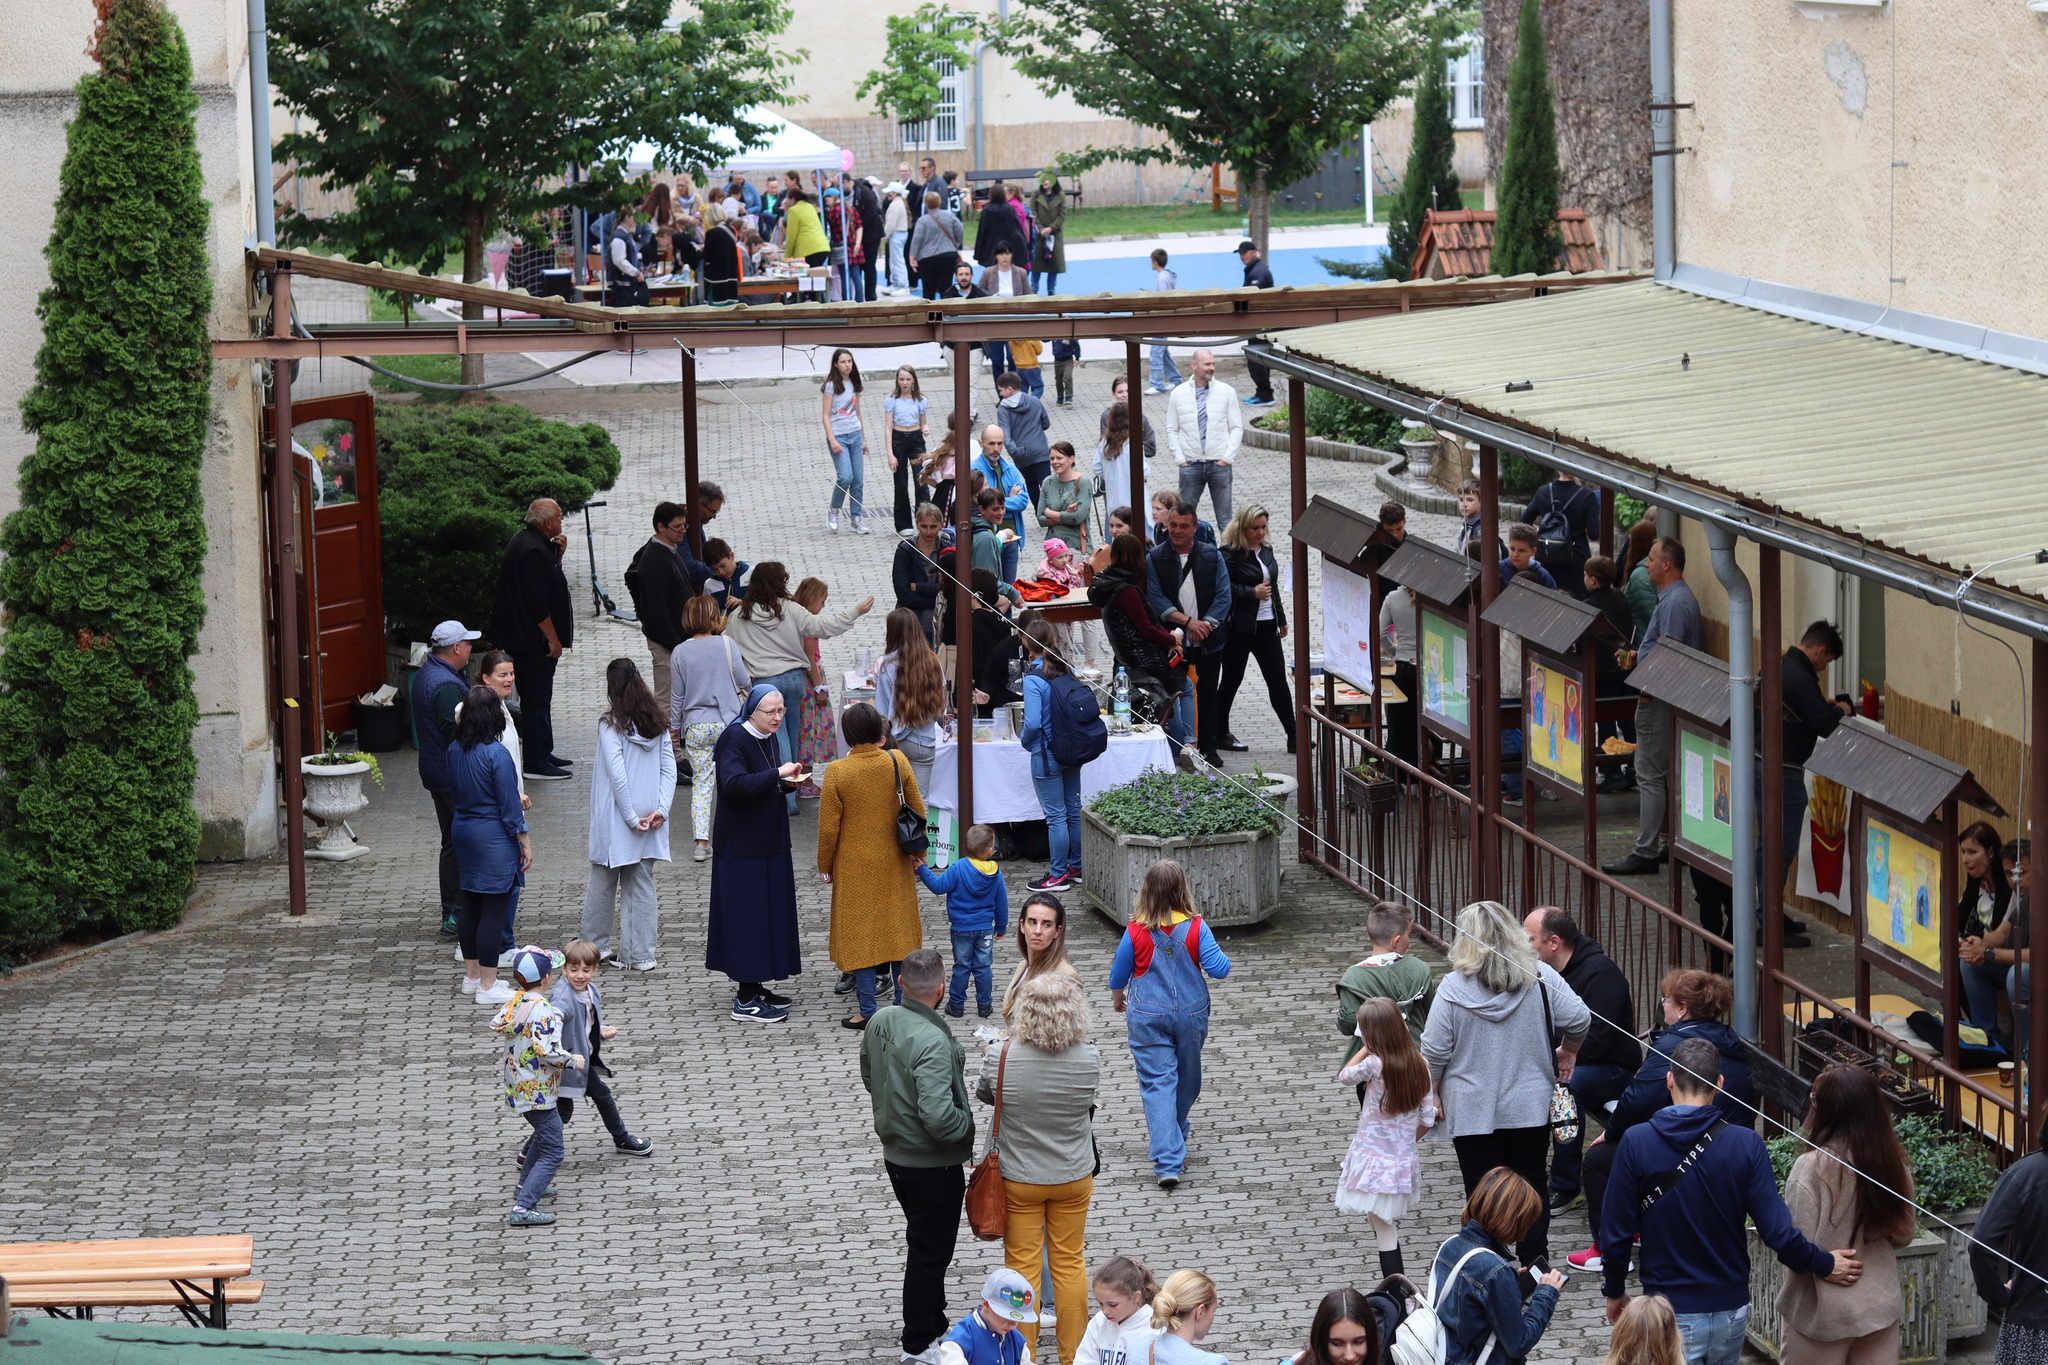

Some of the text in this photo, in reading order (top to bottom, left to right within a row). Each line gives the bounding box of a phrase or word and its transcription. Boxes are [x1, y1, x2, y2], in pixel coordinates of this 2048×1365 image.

[1677, 1133, 1712, 1173] TYPE 7
[1655, 1186, 1662, 1196] 7
